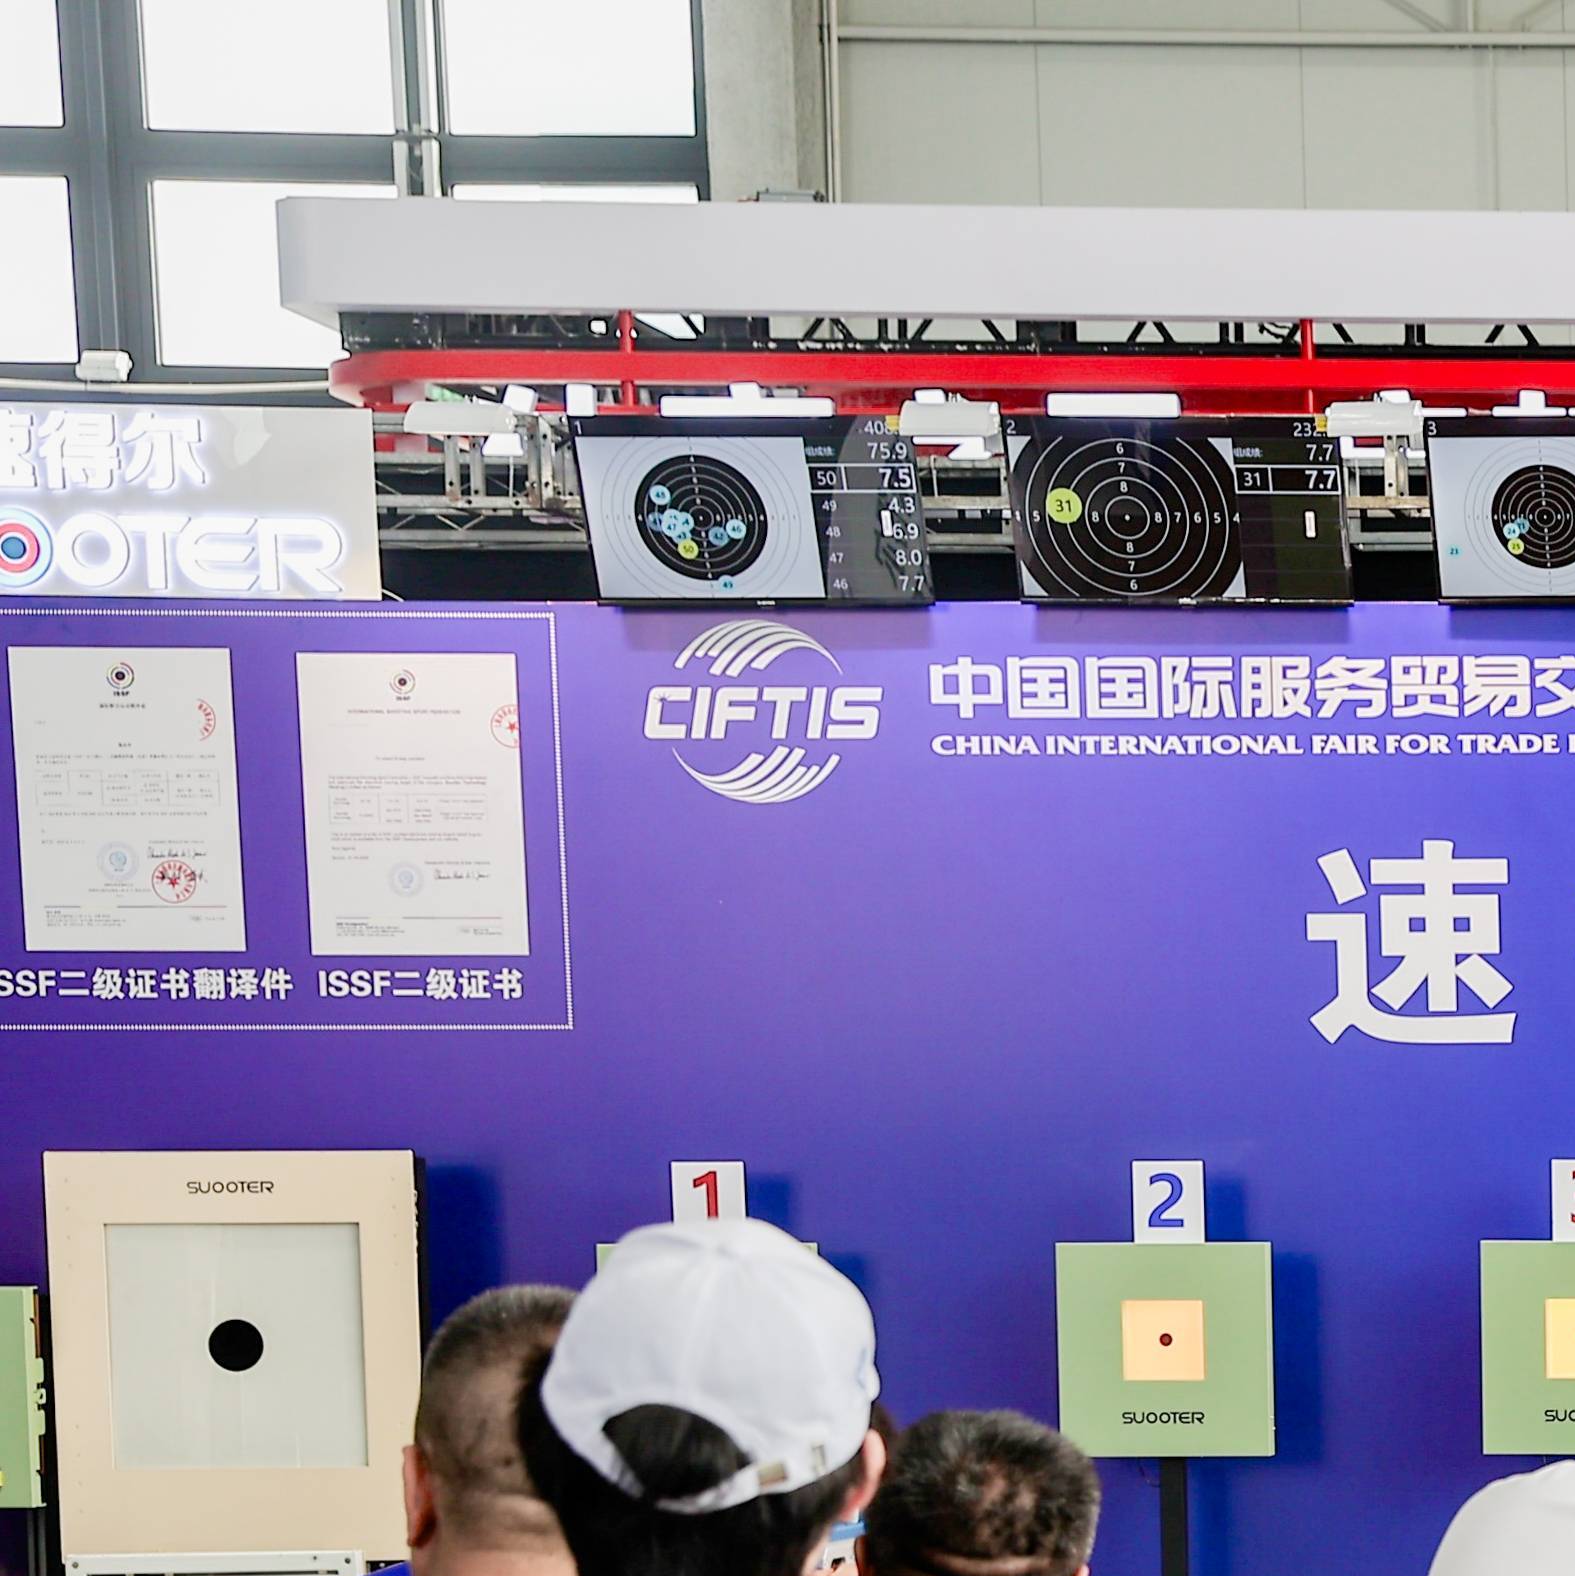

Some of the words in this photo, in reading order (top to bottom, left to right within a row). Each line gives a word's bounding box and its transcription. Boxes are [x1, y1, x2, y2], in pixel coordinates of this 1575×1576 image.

[575, 422, 582, 434] 1
[1007, 420, 1016, 434] 2
[1428, 422, 1437, 436] 3
[867, 442, 908, 460] 75.9
[1306, 444, 1334, 461] 7.7
[816, 471, 837, 486] 50
[878, 468, 912, 488] 7.5
[1243, 472, 1261, 486] 31
[1305, 470, 1336, 489] 7.7
[822, 500, 838, 512] 49
[888, 497, 916, 513] 4.3
[1056, 500, 1073, 512] 31
[826, 526, 841, 538] 48
[893, 523, 919, 539] 6.9
[829, 552, 844, 564] 47
[895, 550, 922, 565] 8.0
[832, 578, 848, 590] 46
[899, 576, 925, 591] 7.7
[643, 685, 884, 741] CIFTIS
[932, 733, 1039, 756] CHINA
[1044, 733, 1303, 756] INTERNATIONAL
[1311, 733, 1380, 756] FAIR
[1386, 733, 1451, 756] FOR
[1457, 733, 1562, 756] TRADE
[318, 968, 524, 1000] ISSF二级证书
[186, 1180, 274, 1194] SUOOTER
[692, 1171, 719, 1221] 1
[1147, 1173, 1185, 1228] 2
[1122, 1411, 1205, 1425] SUOOTER
